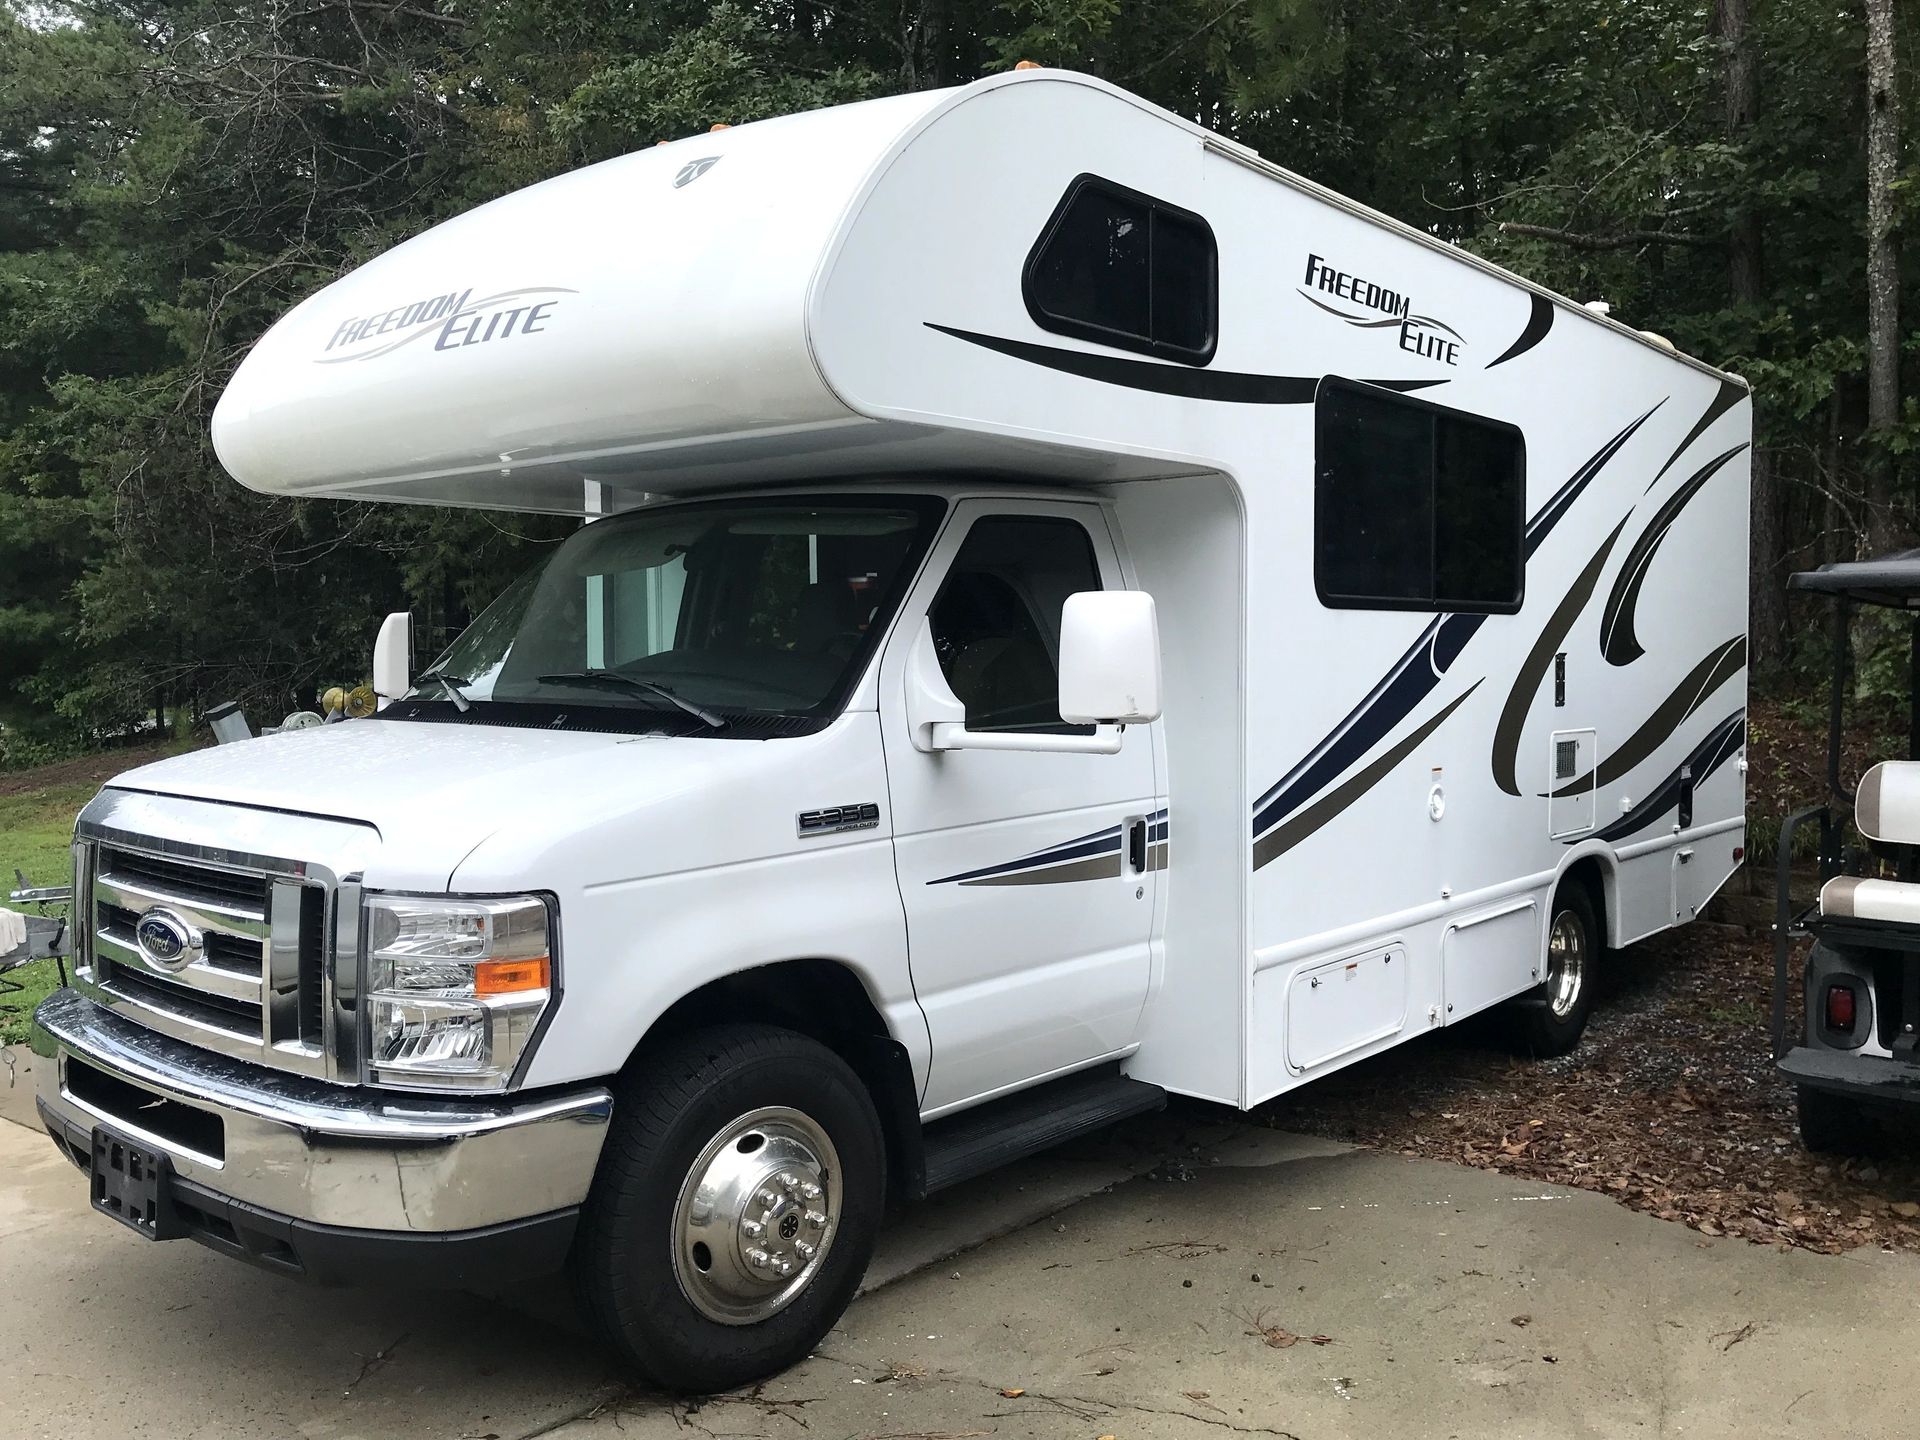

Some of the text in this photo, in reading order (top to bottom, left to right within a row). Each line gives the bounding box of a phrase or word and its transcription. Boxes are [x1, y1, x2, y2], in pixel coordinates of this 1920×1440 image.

[1304, 253, 1410, 320] FREEDOM
[324, 287, 474, 352] FREEDOM
[434, 300, 559, 351] ELITE
[1399, 320, 1460, 366] ELITE
[144, 923, 172, 953] Ford
